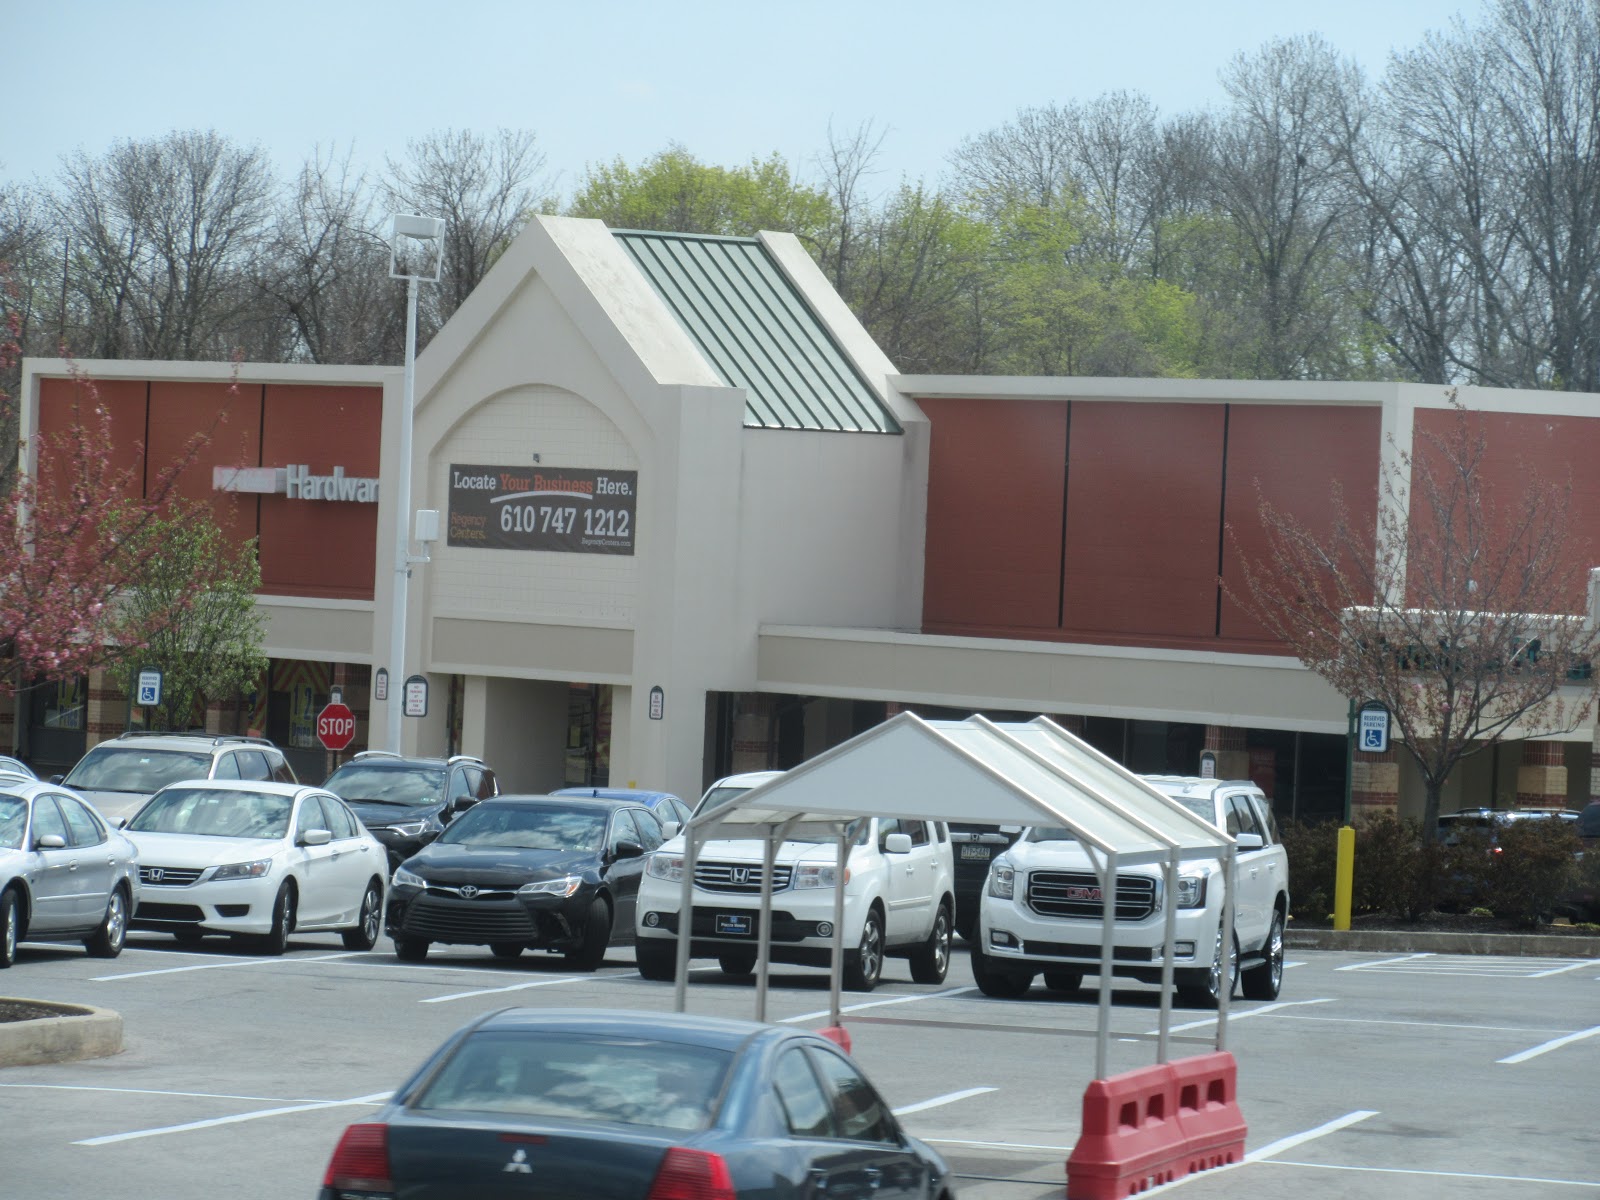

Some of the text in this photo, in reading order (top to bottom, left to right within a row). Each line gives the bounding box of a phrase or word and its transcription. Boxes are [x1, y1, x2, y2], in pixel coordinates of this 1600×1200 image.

[453, 471, 632, 496] Locate Your Business Here.
[451, 512, 486, 526] Regency
[500, 504, 629, 537] 610 747 1212
[319, 717, 353, 736] STOP
